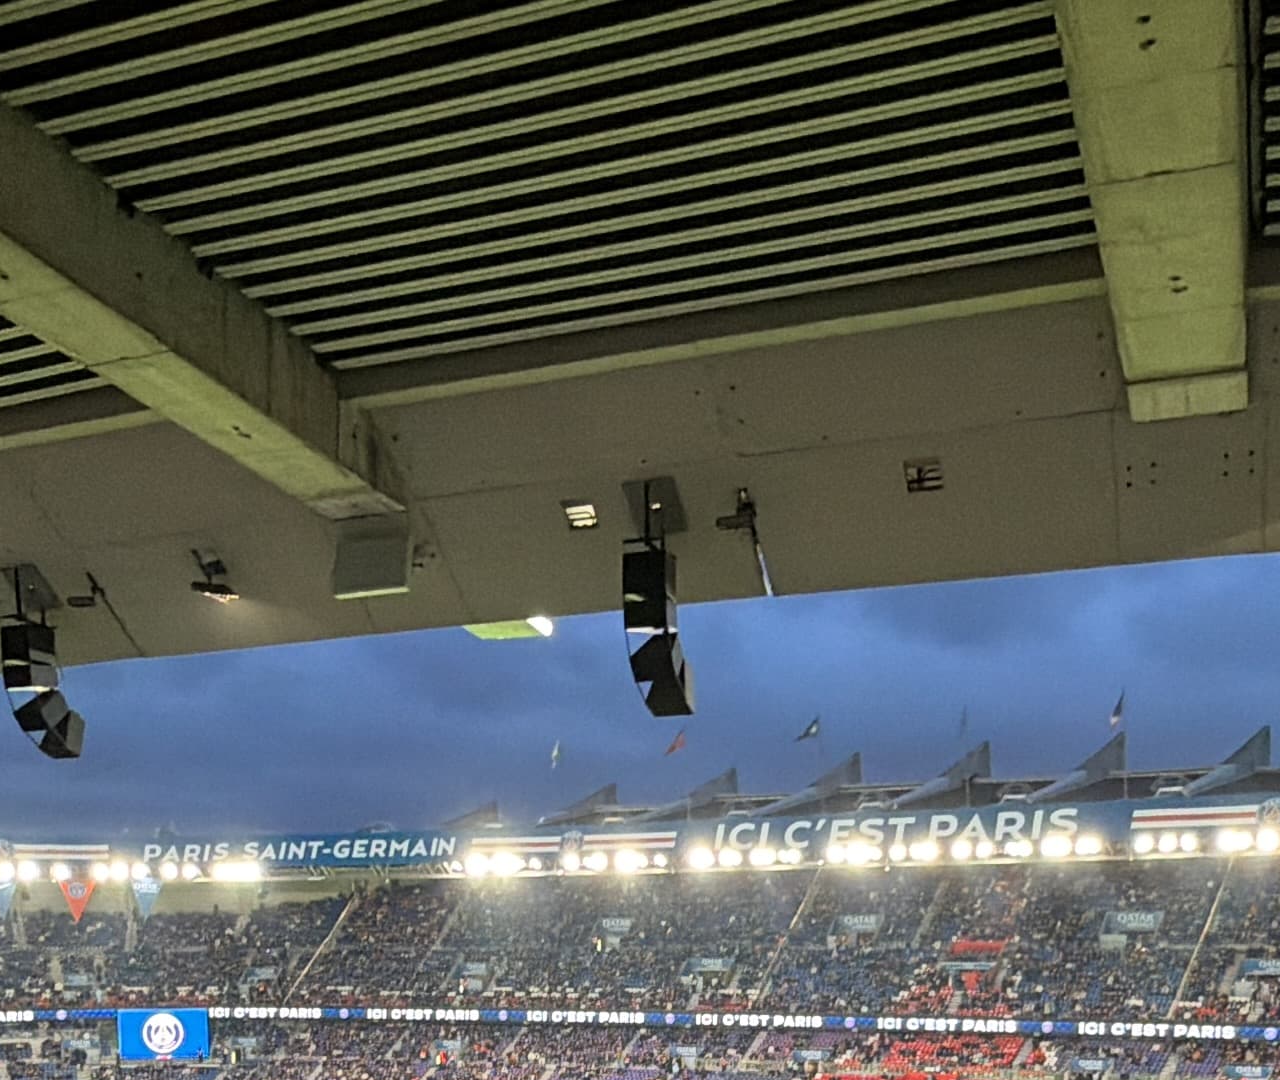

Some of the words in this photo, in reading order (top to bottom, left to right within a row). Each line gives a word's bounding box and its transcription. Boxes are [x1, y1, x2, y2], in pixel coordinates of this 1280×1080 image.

[714, 822, 770, 850] ICI
[928, 807, 1078, 843] PARIS
[143, 842, 230, 864] PARIS
[243, 836, 456, 861] SAINT-GERMAIN
[208, 1007, 230, 1019] ICI
[233, 1007, 276, 1019] C'EST
[279, 1008, 321, 1020] PARIS
[367, 1008, 387, 1020] ICI
[391, 1008, 433, 1020] C'EST
[436, 1009, 479, 1021] PARIS
[527, 1010, 547, 1021] ICI
[552, 1010, 595, 1022] C'EST
[599, 1011, 645, 1024] PARIS
[696, 1013, 718, 1025] ICI
[722, 1014, 769, 1027] C'EST
[773, 1015, 822, 1028] PARIS
[877, 1016, 902, 1029] ICI
[906, 1017, 958, 1031] C'EST
[962, 1018, 1017, 1033] PARIS
[1078, 1022, 1105, 1035] ICI
[1111, 1023, 1168, 1038] C'EST
[1173, 1024, 1235, 1039] PARIS
